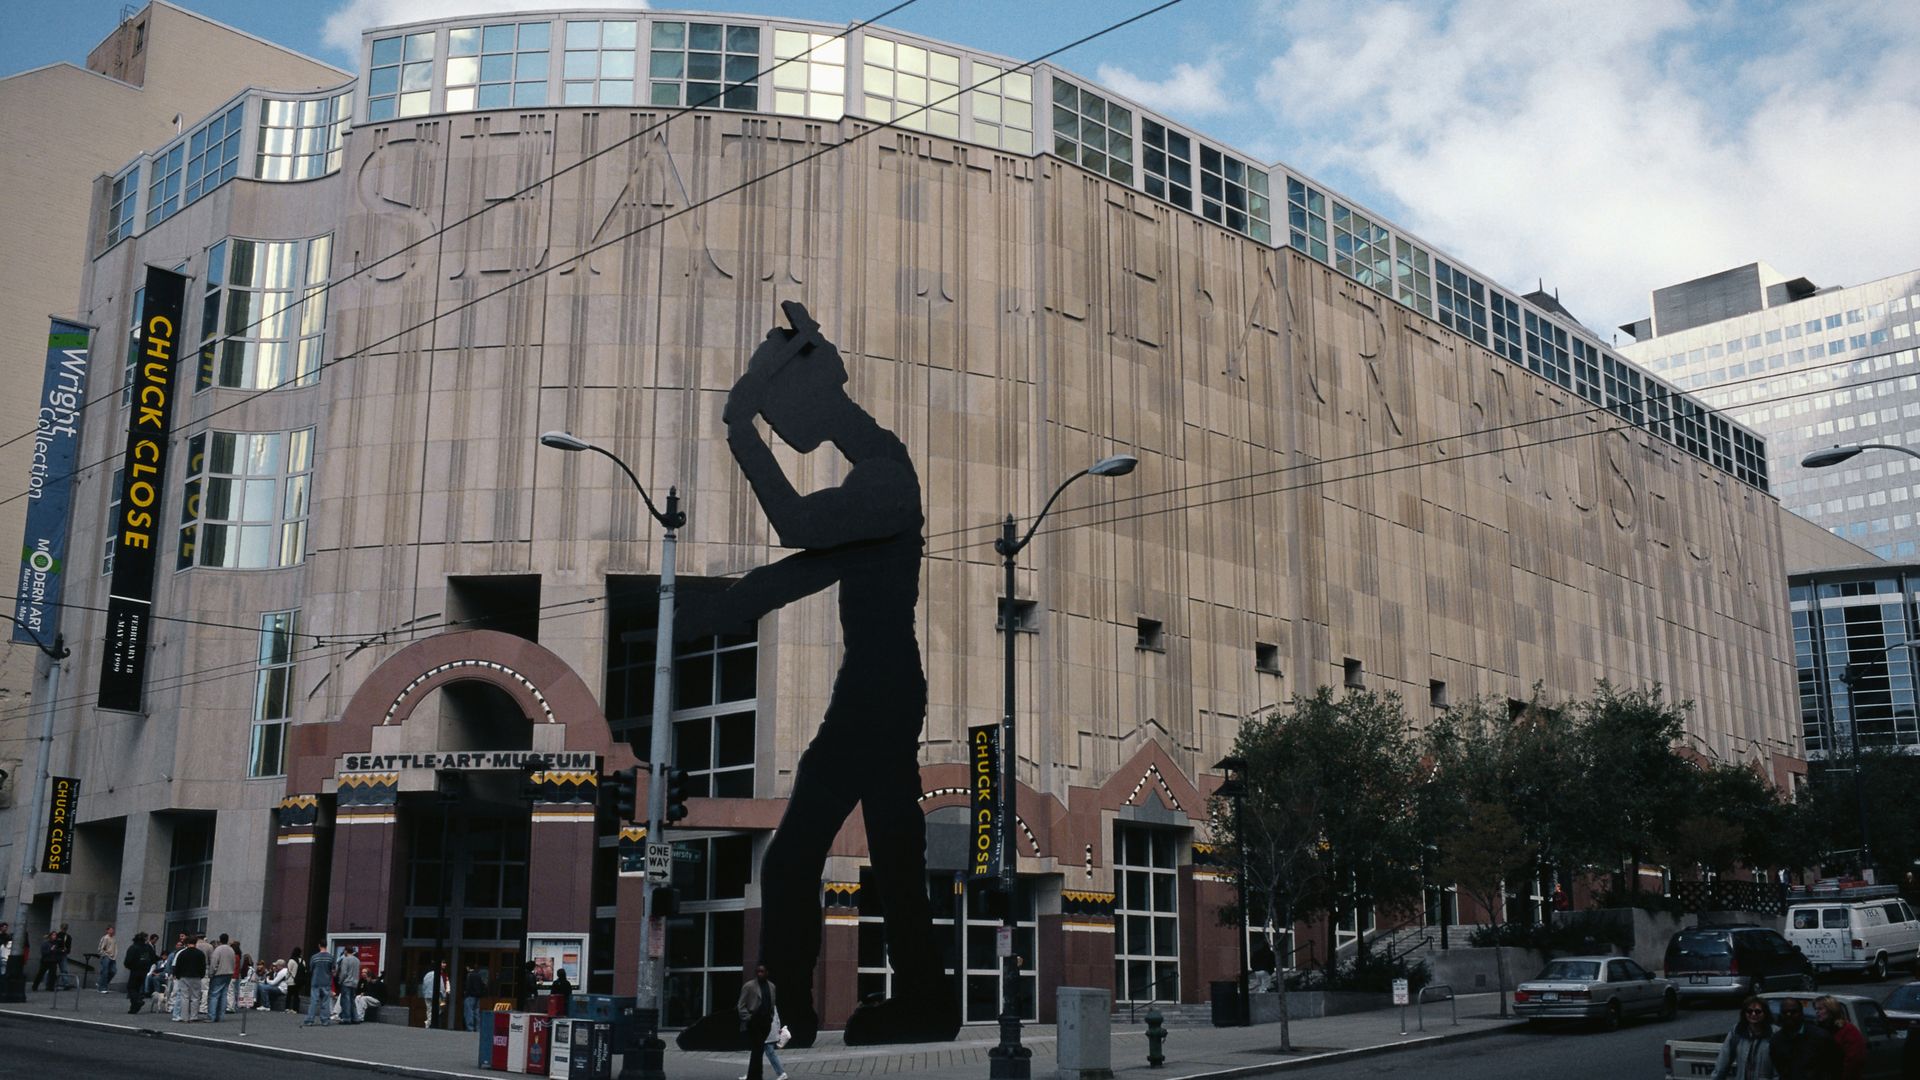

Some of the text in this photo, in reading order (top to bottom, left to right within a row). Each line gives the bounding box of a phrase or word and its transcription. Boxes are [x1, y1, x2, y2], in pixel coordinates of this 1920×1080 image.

[50, 349, 88, 437] Wright
[124, 315, 173, 549] CHUCK CLOSE
[28, 407, 55, 499] Collection
[22, 567, 31, 591] March
[28, 538, 53, 632] MODERN ART
[17, 605, 27, 622] May
[117, 620, 125, 639] MAY
[113, 652, 121, 672] 1999
[126, 614, 139, 674] FEBRUARY 18
[346, 752, 591, 770] SEATTLE ART MUSEUM
[54, 781, 69, 824] CHUCK
[976, 731, 991, 874] CHUCK CLOSE
[49, 829, 63, 870] CLOSE
[649, 846, 669, 857] ONE
[649, 857, 670, 867] WAY
